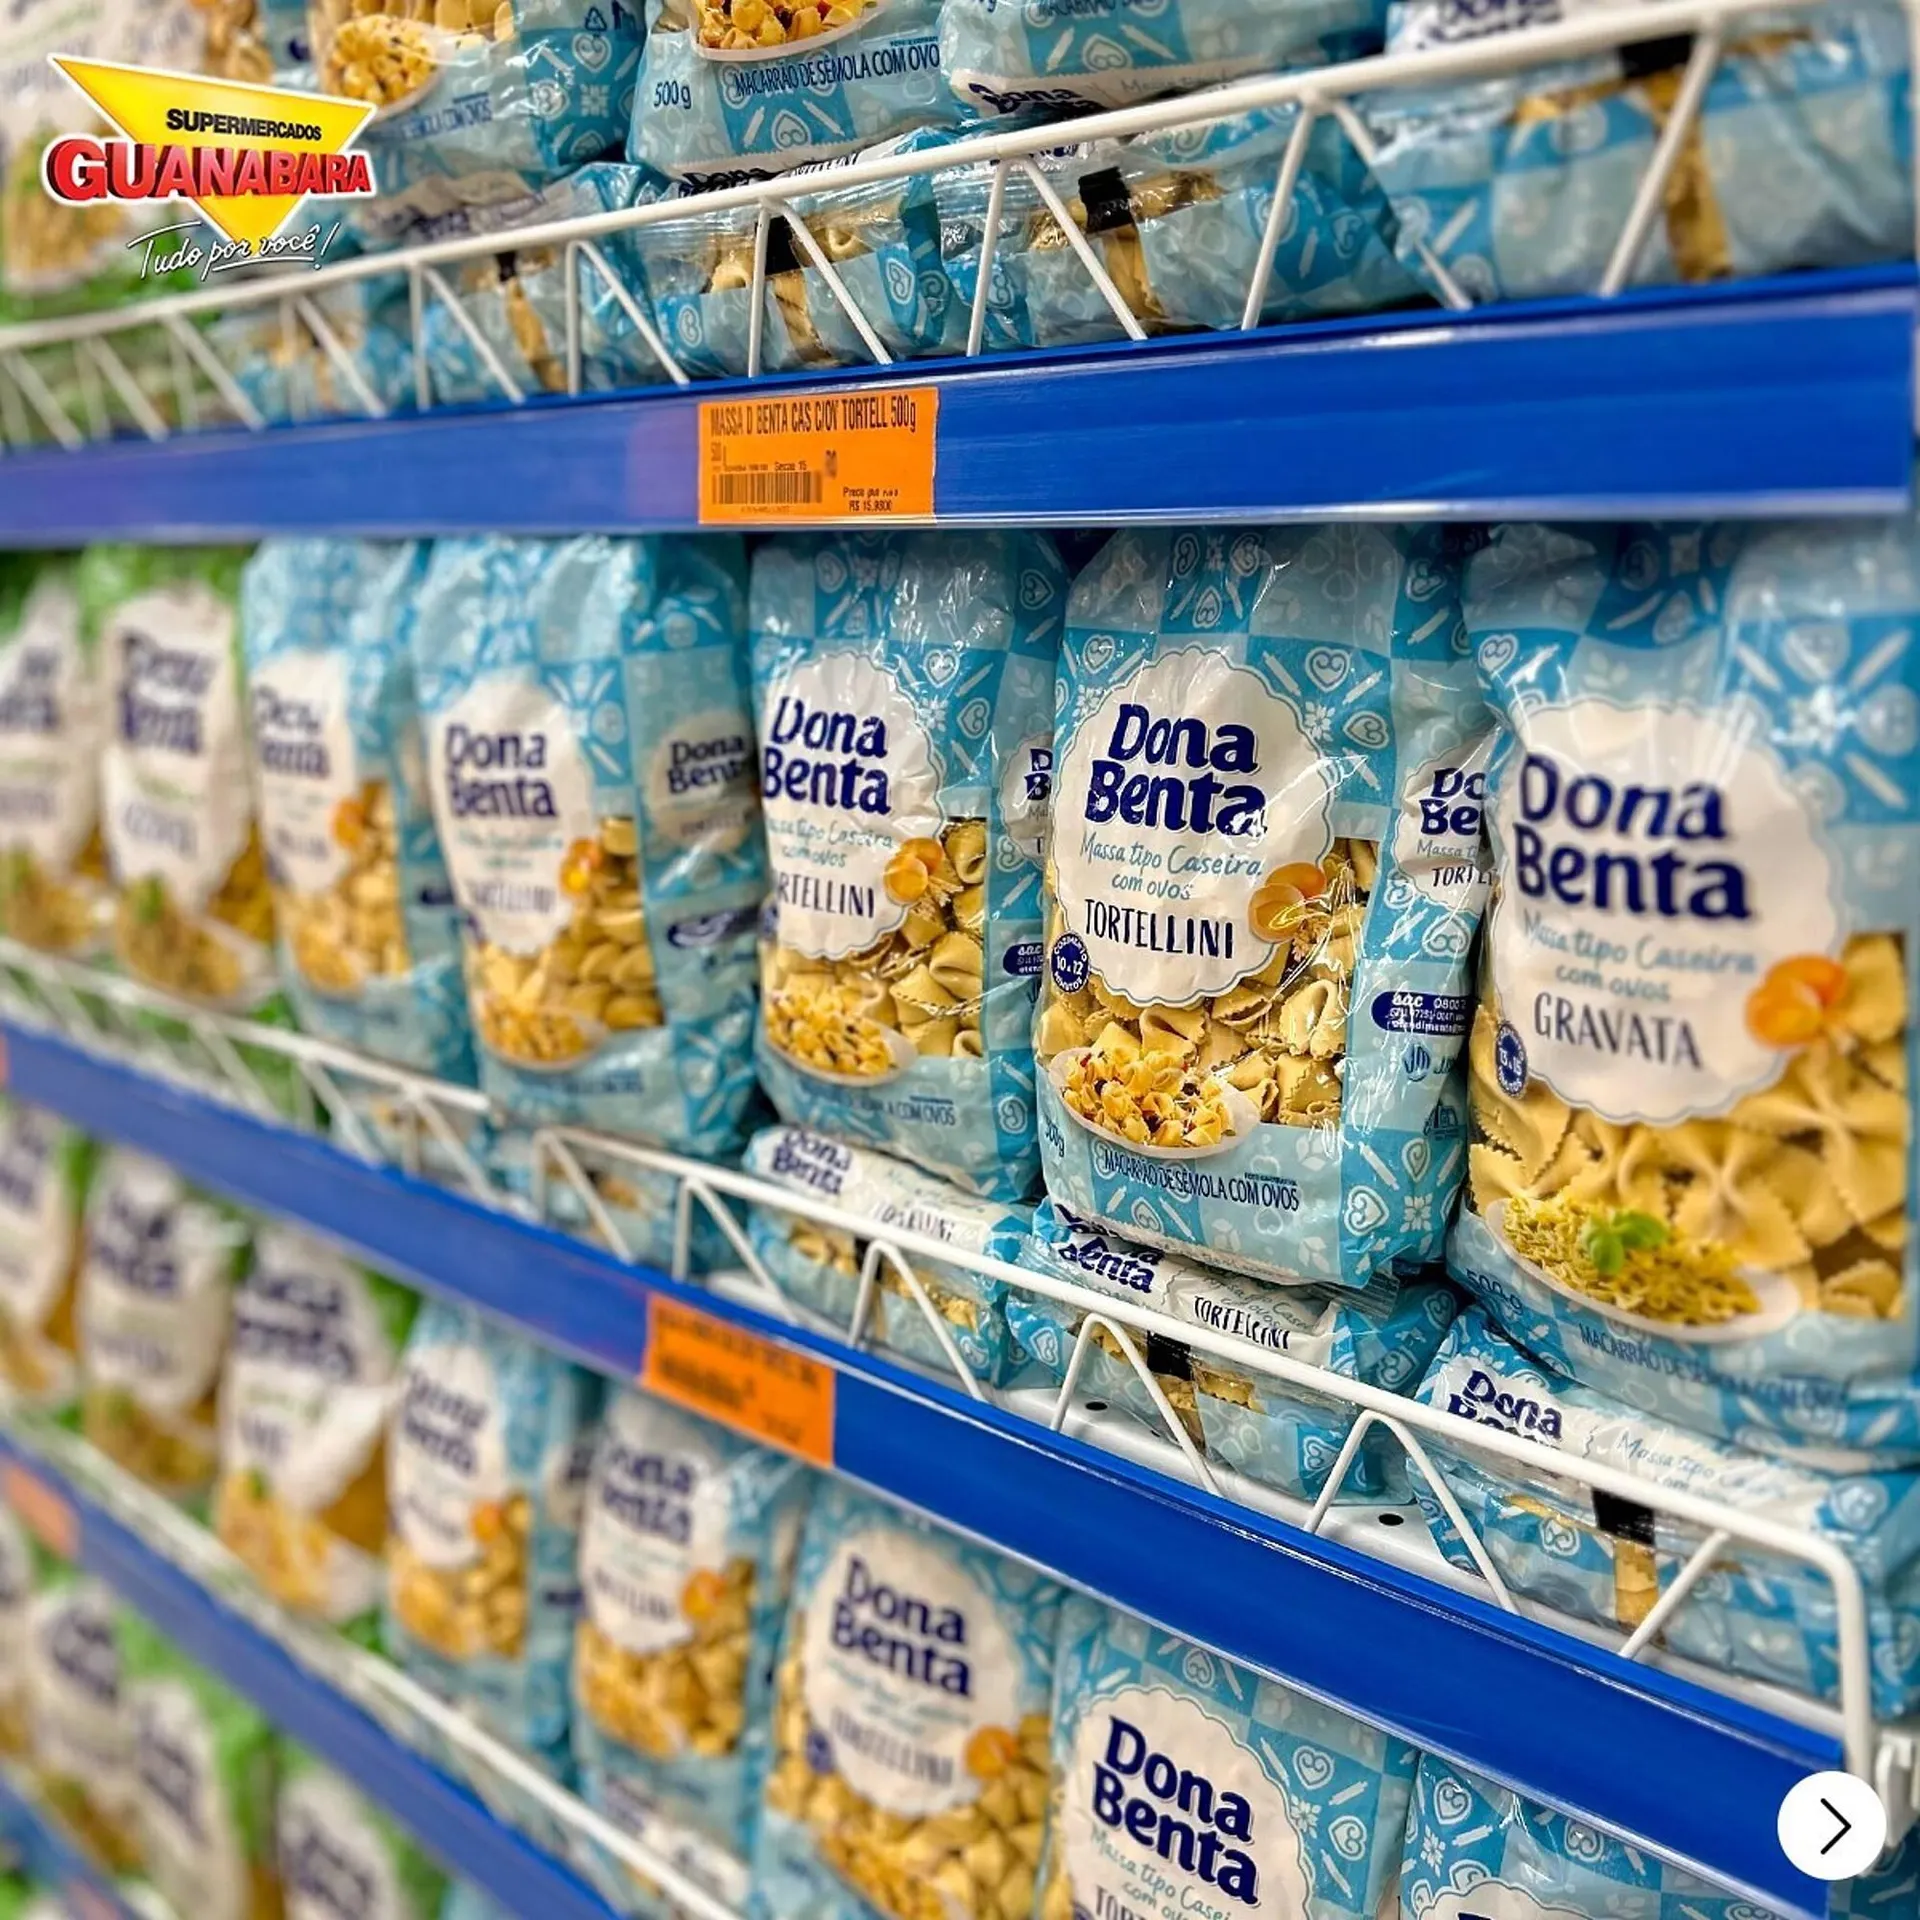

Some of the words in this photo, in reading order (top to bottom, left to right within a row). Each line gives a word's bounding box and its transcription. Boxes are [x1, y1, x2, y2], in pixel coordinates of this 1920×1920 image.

[734, 64, 800, 97] MACARRÃO
[800, 61, 817, 87] DE
[815, 54, 870, 85] SÊMOLA
[872, 46, 906, 76] COM
[711, 406, 744, 436] MASSA
[756, 402, 788, 434] BENTA
[842, 395, 888, 430] TORTELL
[446, 723, 547, 769] Dona
[670, 734, 745, 768] Dona
[771, 696, 888, 759] Dona
[1107, 703, 1260, 775] Dona
[763, 745, 892, 816] Benta
[1083, 759, 1268, 837] Benta
[1519, 752, 1728, 841] Dona
[1079, 832, 1127, 865] Massa
[1129, 841, 1163, 877] tipo
[1167, 844, 1263, 877] Caseira
[1416, 839, 1463, 858] Massa
[1511, 821, 1755, 920] Benta
[1112, 873, 1144, 893] com
[1146, 879, 1192, 901] ovos
[1083, 898, 1234, 960] TORTELLINI
[1574, 927, 1629, 972] tipo
[1057, 955, 1066, 970] 10
[1555, 963, 1604, 989] com
[1533, 990, 1705, 1071] GRAVATA
[1103, 1148, 1158, 1187] MACARRÃO
[1157, 1163, 1174, 1188] DE
[1174, 1167, 1227, 1201] SÊMOLA
[1228, 1177, 1260, 1206] COM
[1261, 1183, 1299, 1211] OVOS
[1463, 1369, 1564, 1442] Dona
[1616, 1429, 1673, 1468] Massa
[847, 1552, 967, 1645] Dona
[832, 1597, 976, 1699] Benta
[1108, 1714, 1254, 1843] Dona
[1092, 1759, 1260, 1907] Benta
[1121, 1881, 1158, 1910] com
[1140, 1863, 1177, 1898] tipo
